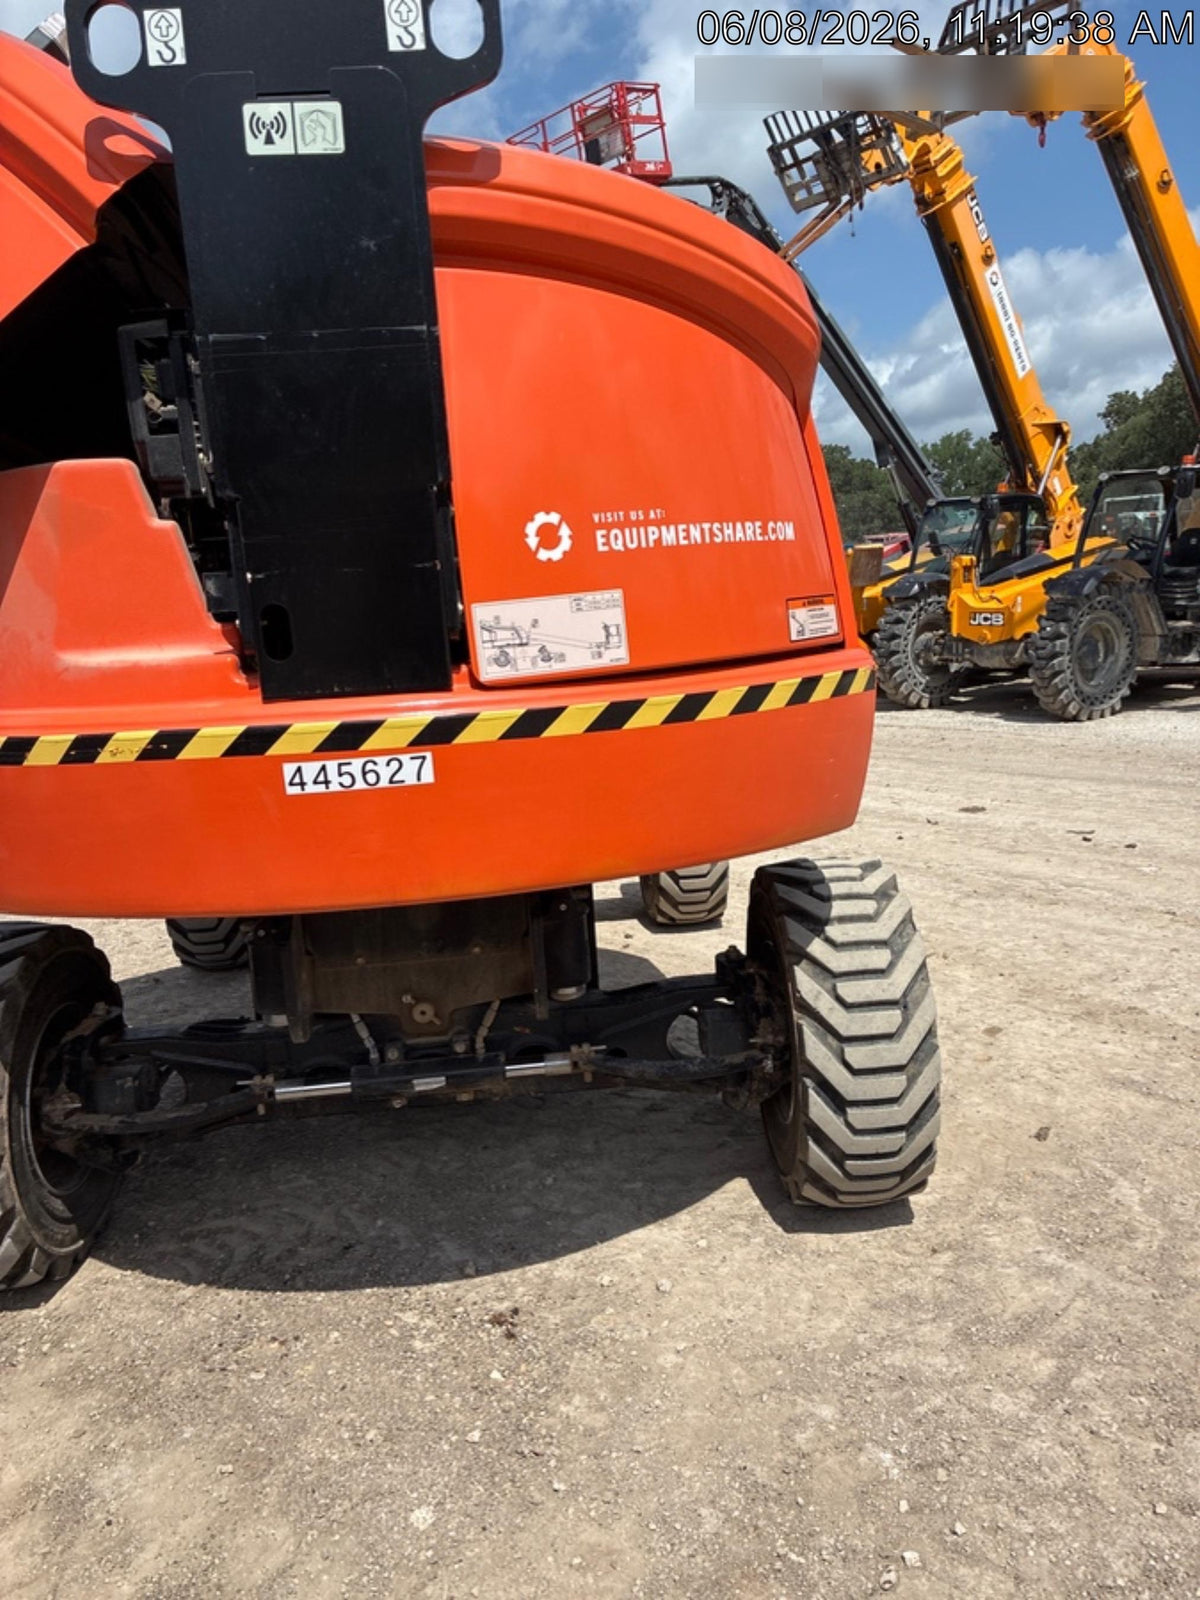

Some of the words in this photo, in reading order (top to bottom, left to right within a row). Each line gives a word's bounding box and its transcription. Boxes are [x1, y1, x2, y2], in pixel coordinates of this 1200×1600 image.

[967, 193, 988, 242] JCB
[592, 511, 625, 524] VISIT
[630, 509, 645, 521] US
[649, 508, 666, 520] AT:
[595, 520, 796, 552] EQUIPMENTSHARE.COM
[970, 612, 1004, 625] JCB
[288, 755, 428, 792] 445627
